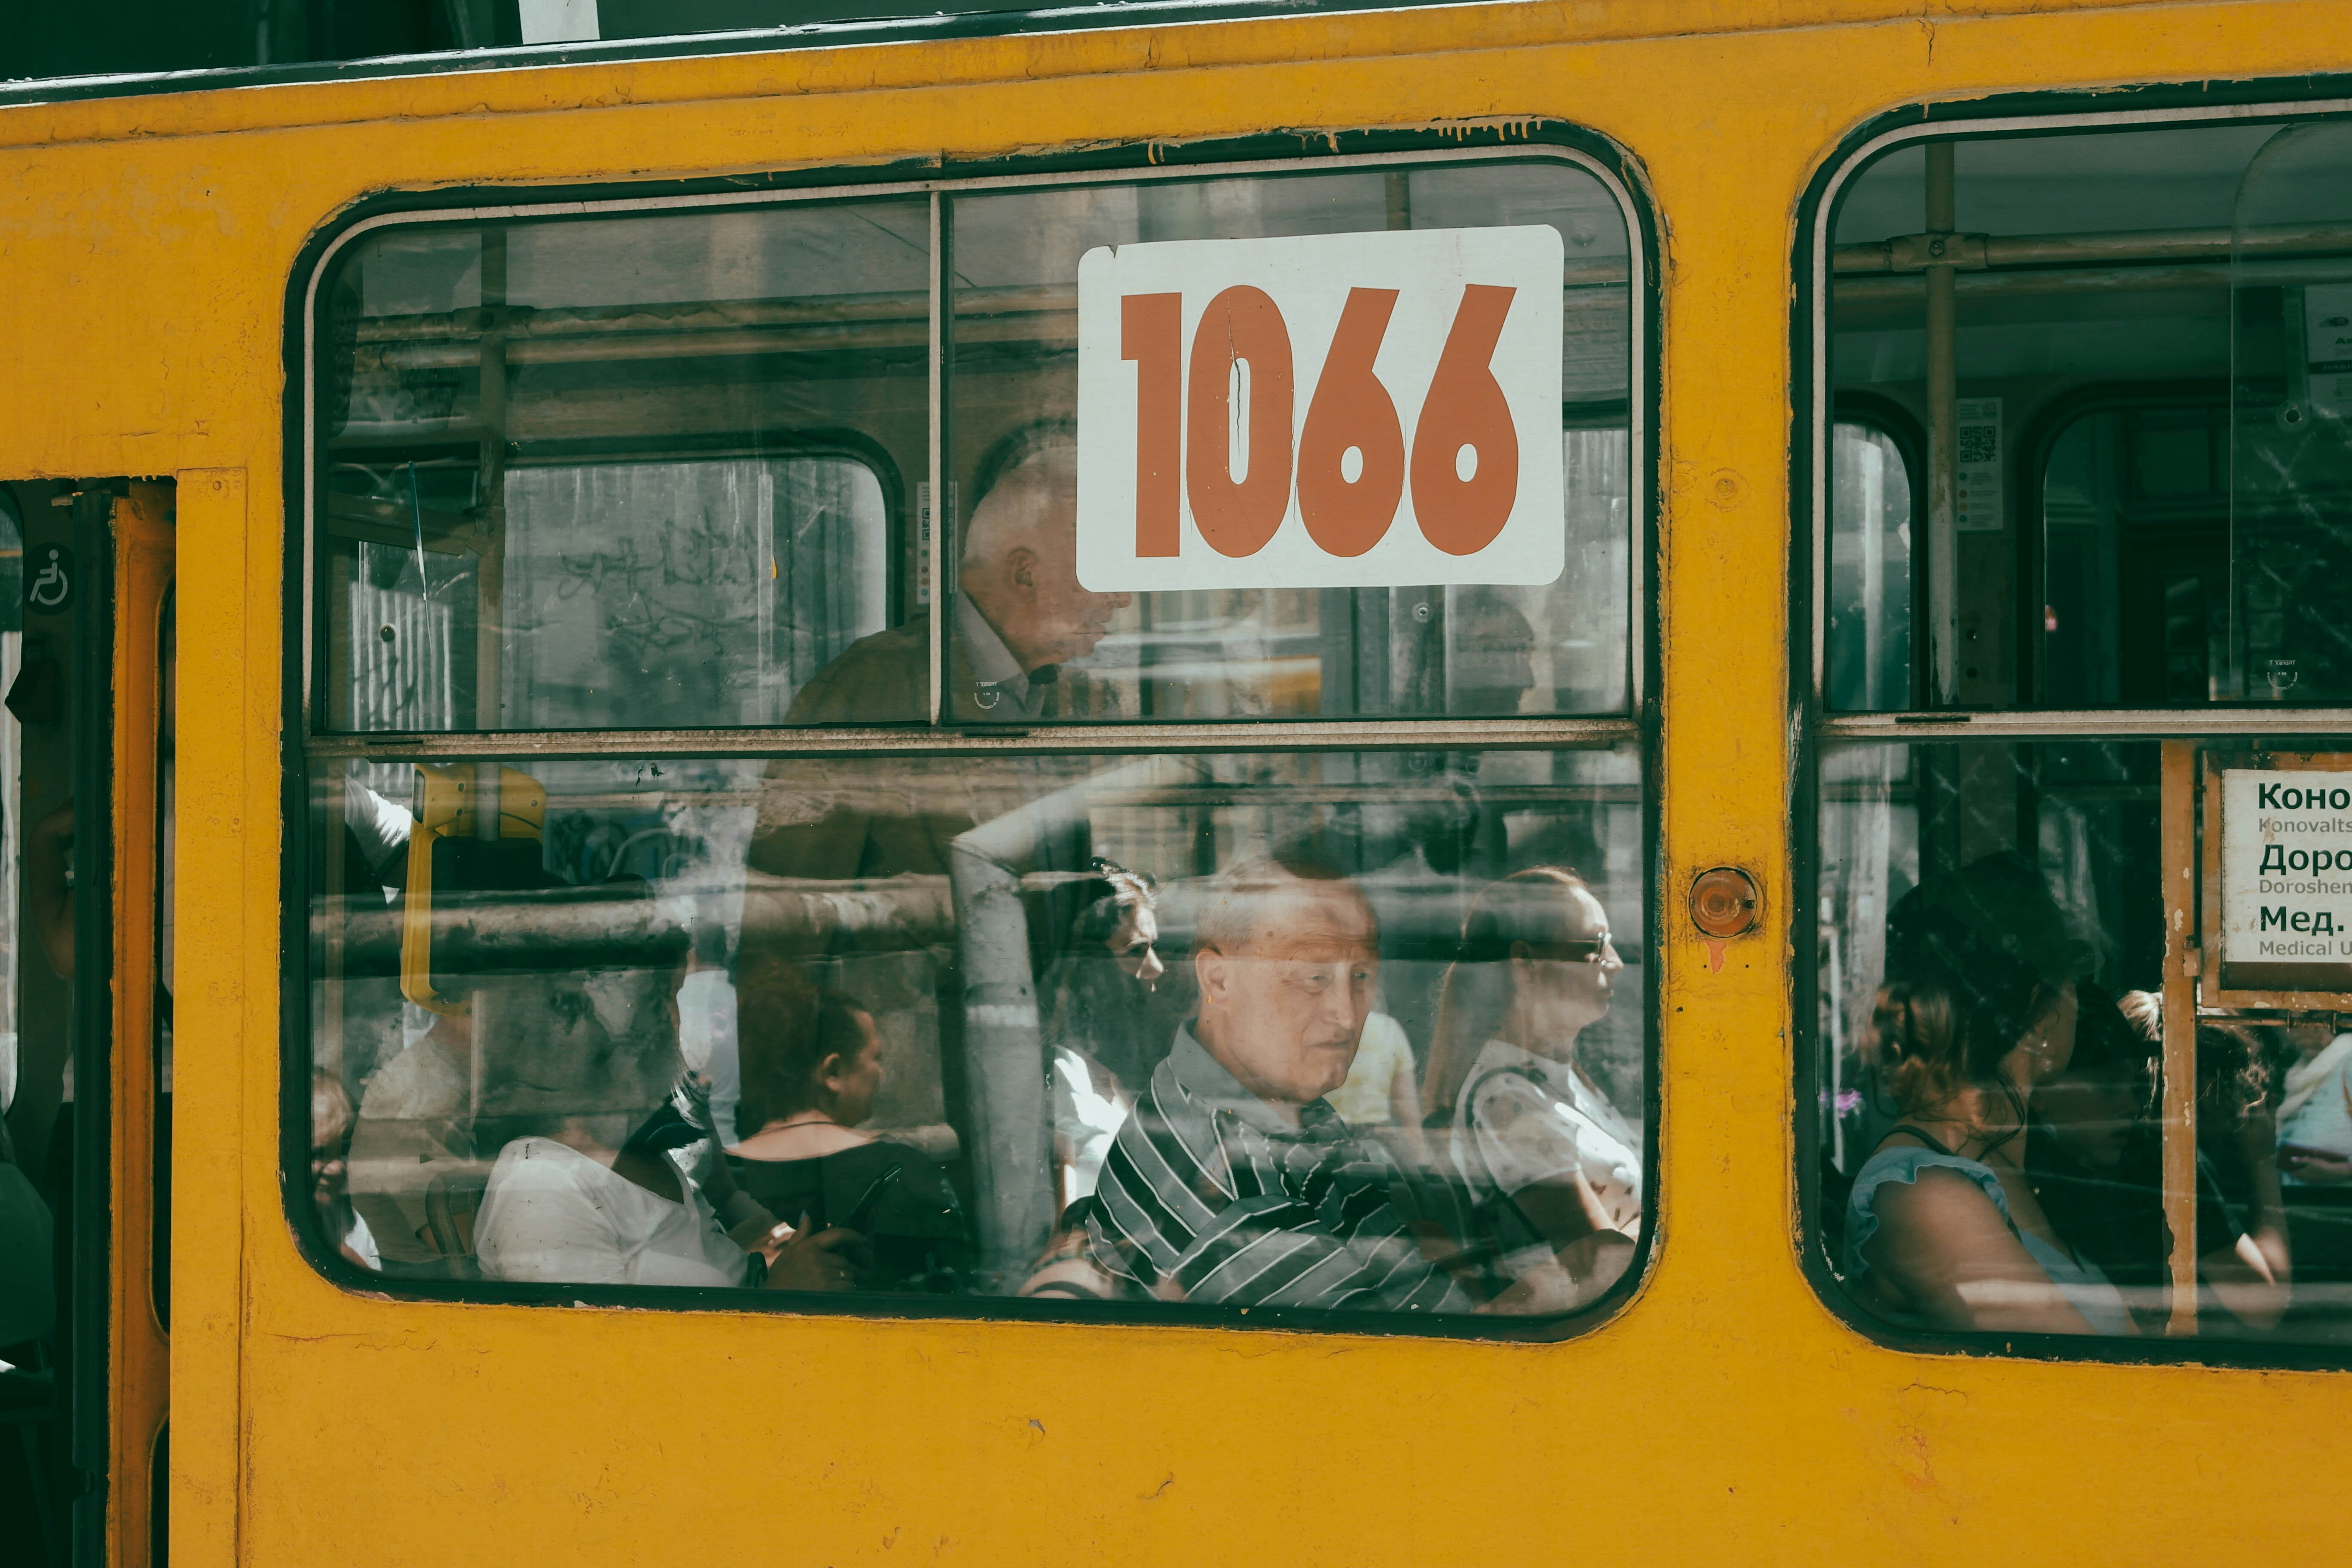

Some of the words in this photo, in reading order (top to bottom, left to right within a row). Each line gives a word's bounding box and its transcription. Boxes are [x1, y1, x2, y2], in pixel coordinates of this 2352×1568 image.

[1121, 285, 1519, 557] 1066
[2259, 783, 2350, 810] Коно
[2259, 818, 2352, 833] Konovalts
[2259, 844, 2352, 877] Доро
[2259, 879, 2352, 894] Doroshen
[2260, 906, 2344, 936] Мед.
[2260, 940, 2332, 956] Medical
